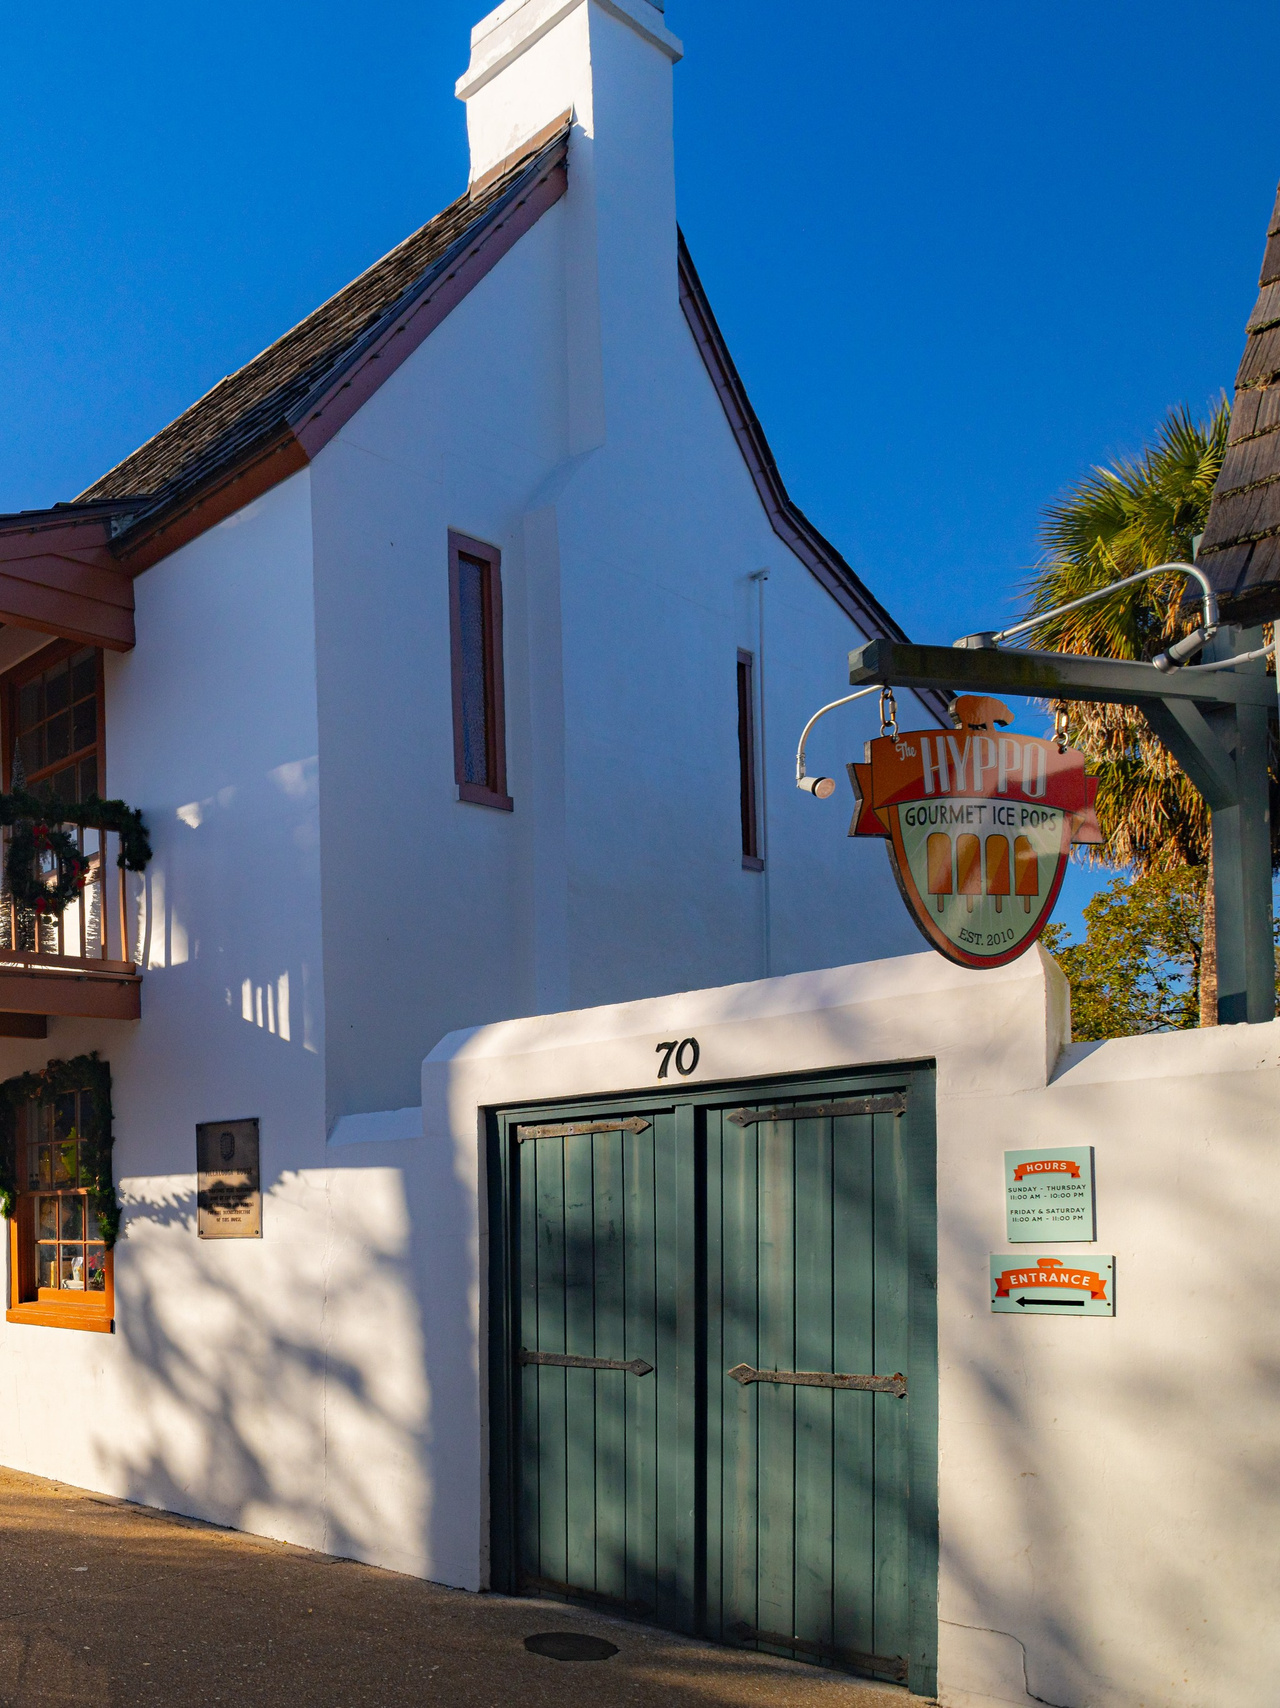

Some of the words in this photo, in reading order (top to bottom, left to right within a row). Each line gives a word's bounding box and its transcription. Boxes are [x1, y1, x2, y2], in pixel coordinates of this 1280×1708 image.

[895, 741, 917, 761] The
[920, 735, 1048, 798] HYPPO
[905, 805, 987, 827] GOURMET
[992, 806, 1015, 826] ICE
[1021, 808, 1057, 832] POPS
[958, 927, 984, 946] EST.
[986, 928, 1015, 946] 2010
[655, 1037, 700, 1079] 70
[1026, 1162, 1067, 1172] HOURS
[1046, 1184, 1086, 1192] THURSDAY
[1009, 1272, 1091, 1286] ENTRANCE
